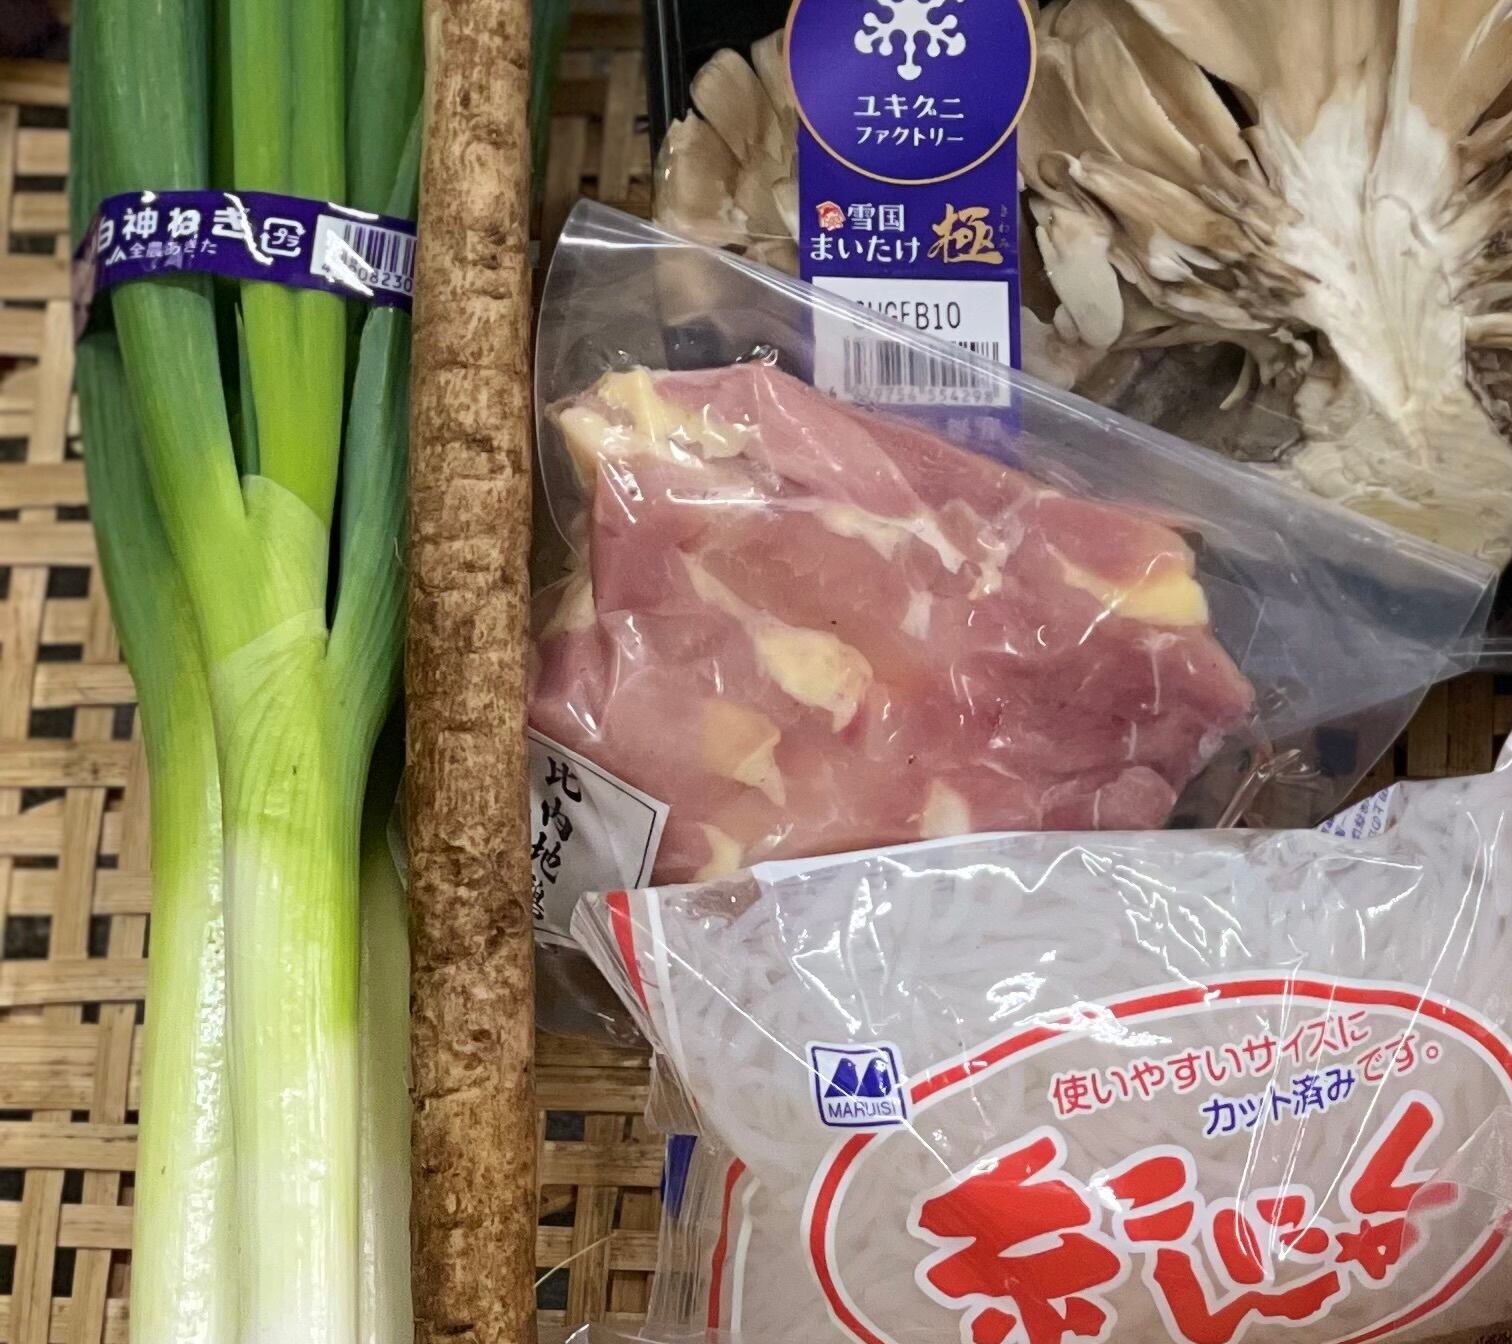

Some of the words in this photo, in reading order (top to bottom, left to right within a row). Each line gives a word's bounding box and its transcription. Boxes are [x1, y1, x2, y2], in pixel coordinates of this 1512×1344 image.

[853, 94, 965, 120] ユキグニ
[856, 125, 964, 147] ファクトリー
[847, 203, 906, 234] 雪国
[926, 203, 1004, 266] 極
[809, 235, 921, 265] まいたけ
[1052, 1010, 1371, 1115] 使いやすいサイズに
